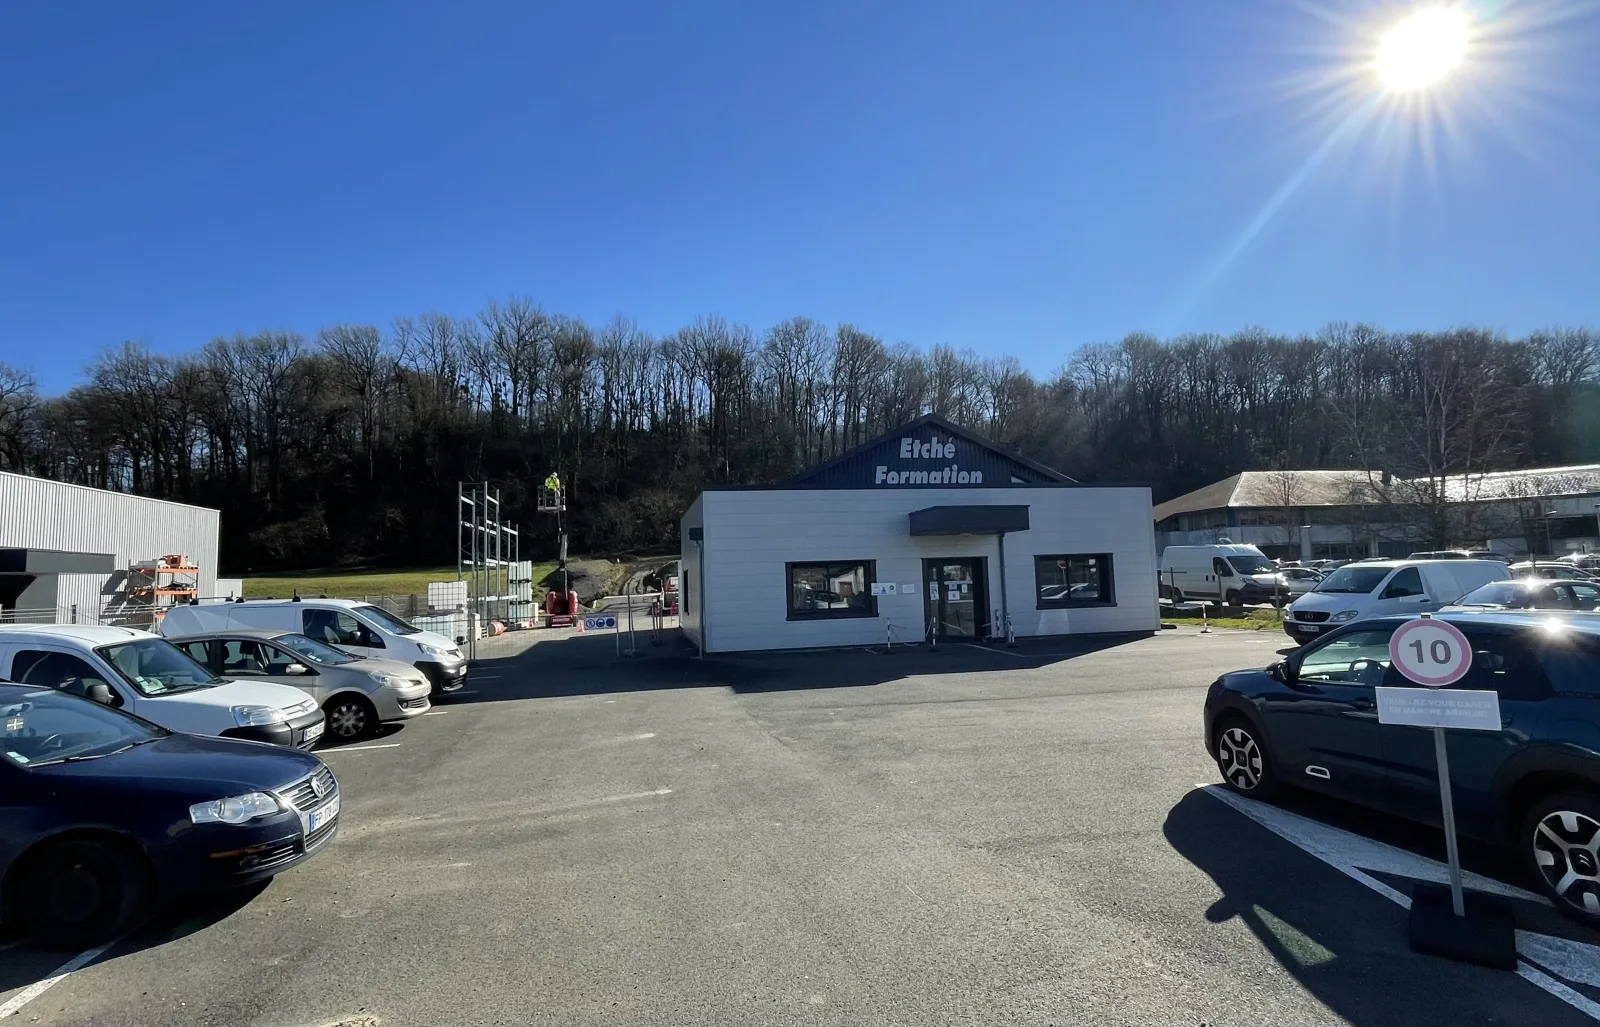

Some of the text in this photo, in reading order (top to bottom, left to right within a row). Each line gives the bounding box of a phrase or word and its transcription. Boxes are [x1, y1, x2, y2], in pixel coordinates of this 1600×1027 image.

[900, 437, 956, 458] Etché
[875, 464, 983, 484] Formation
[1409, 640, 1451, 664] 10
